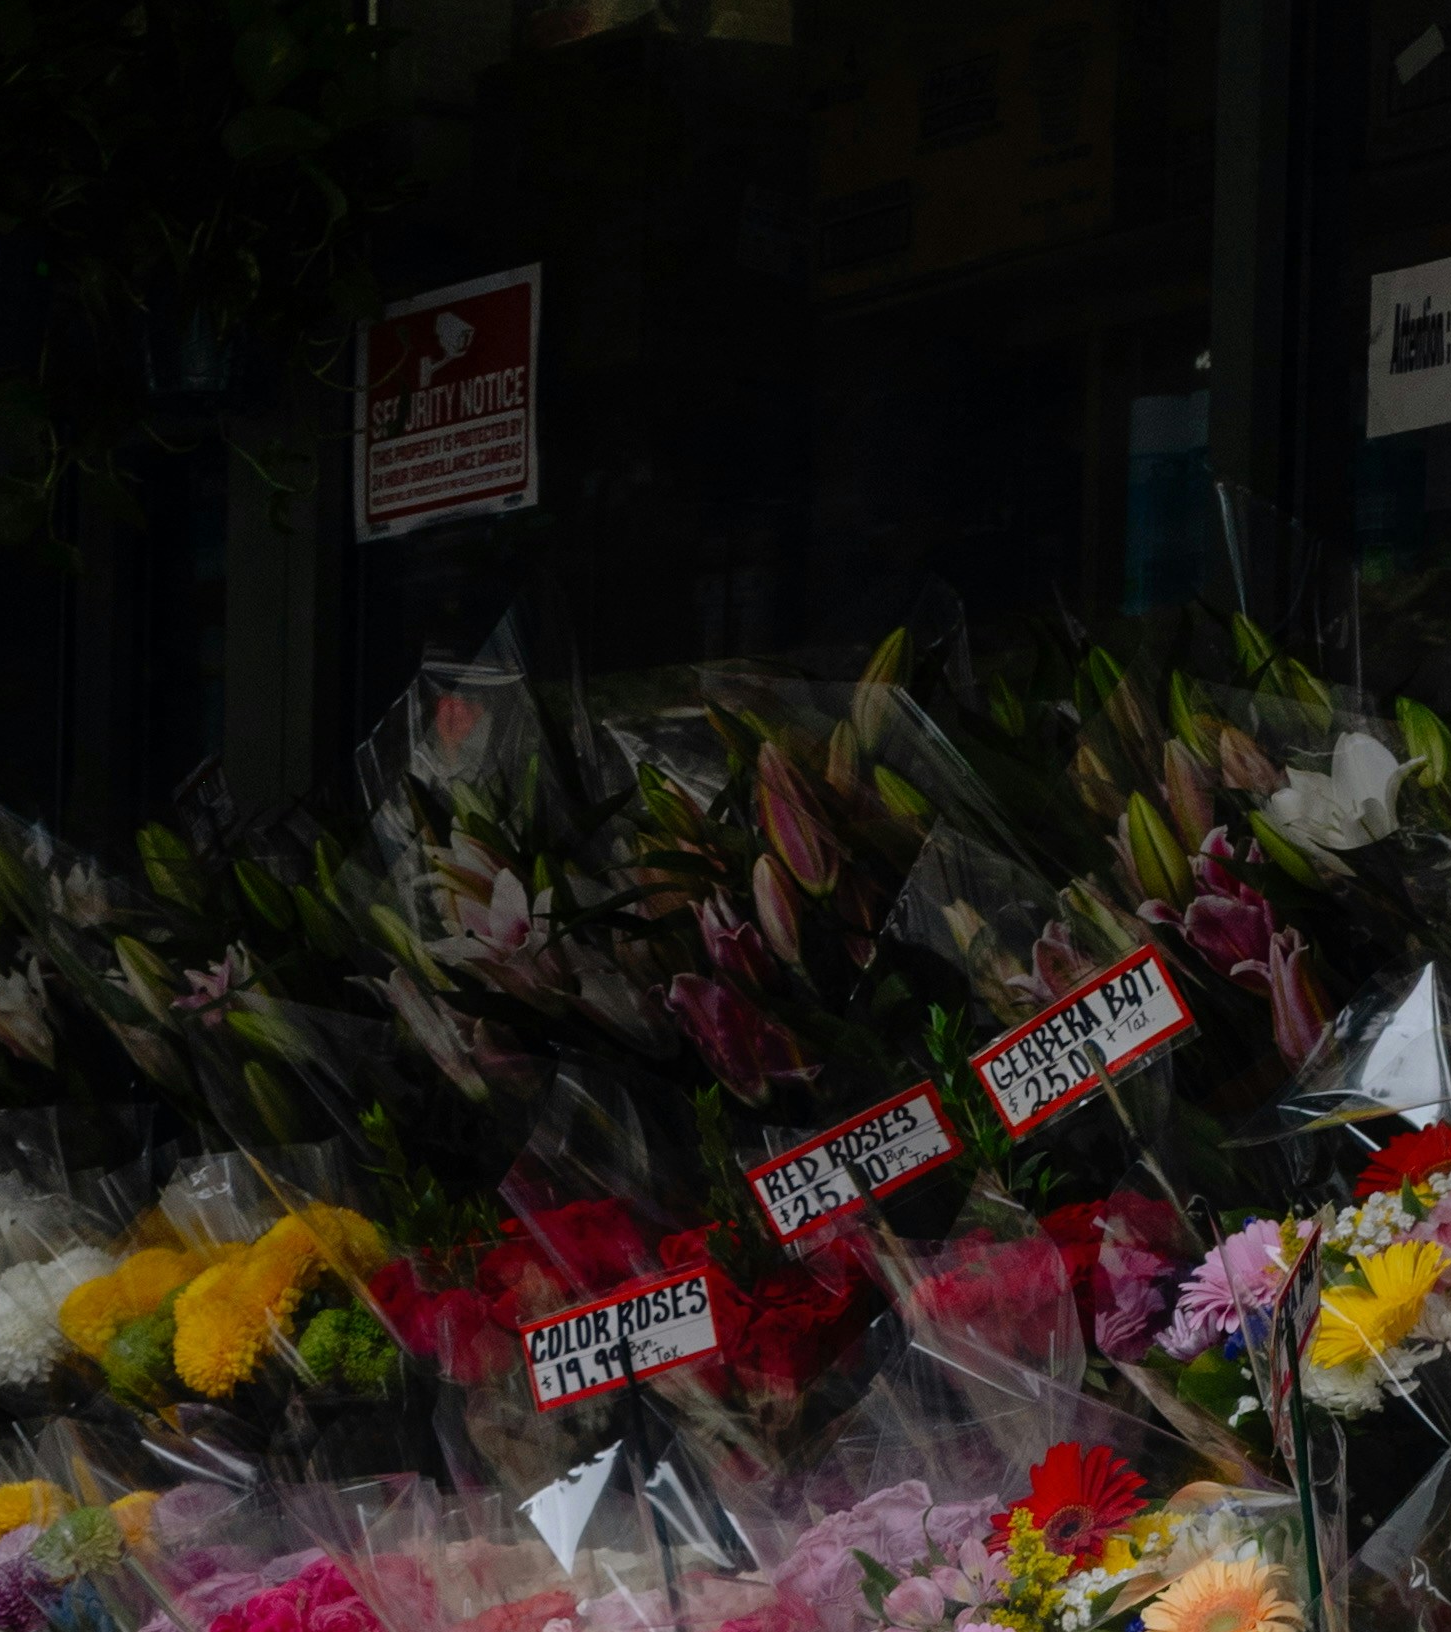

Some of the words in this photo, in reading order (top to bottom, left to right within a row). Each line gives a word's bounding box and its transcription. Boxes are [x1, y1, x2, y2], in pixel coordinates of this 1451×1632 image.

[1389, 296, 1444, 375] Attention
[460, 366, 525, 419] NOTICE
[395, 437, 442, 462] PROPERTY
[454, 422, 507, 449] PROTECTED
[479, 442, 523, 466] CAMERAS
[990, 999, 1102, 1090] GERBERA
[762, 1157, 819, 1204] RED
[825, 1107, 918, 1169] ROSES
[778, 1151, 889, 1228] $25.0
[530, 1309, 611, 1364] COLOR
[617, 1278, 707, 1336] ROSES
